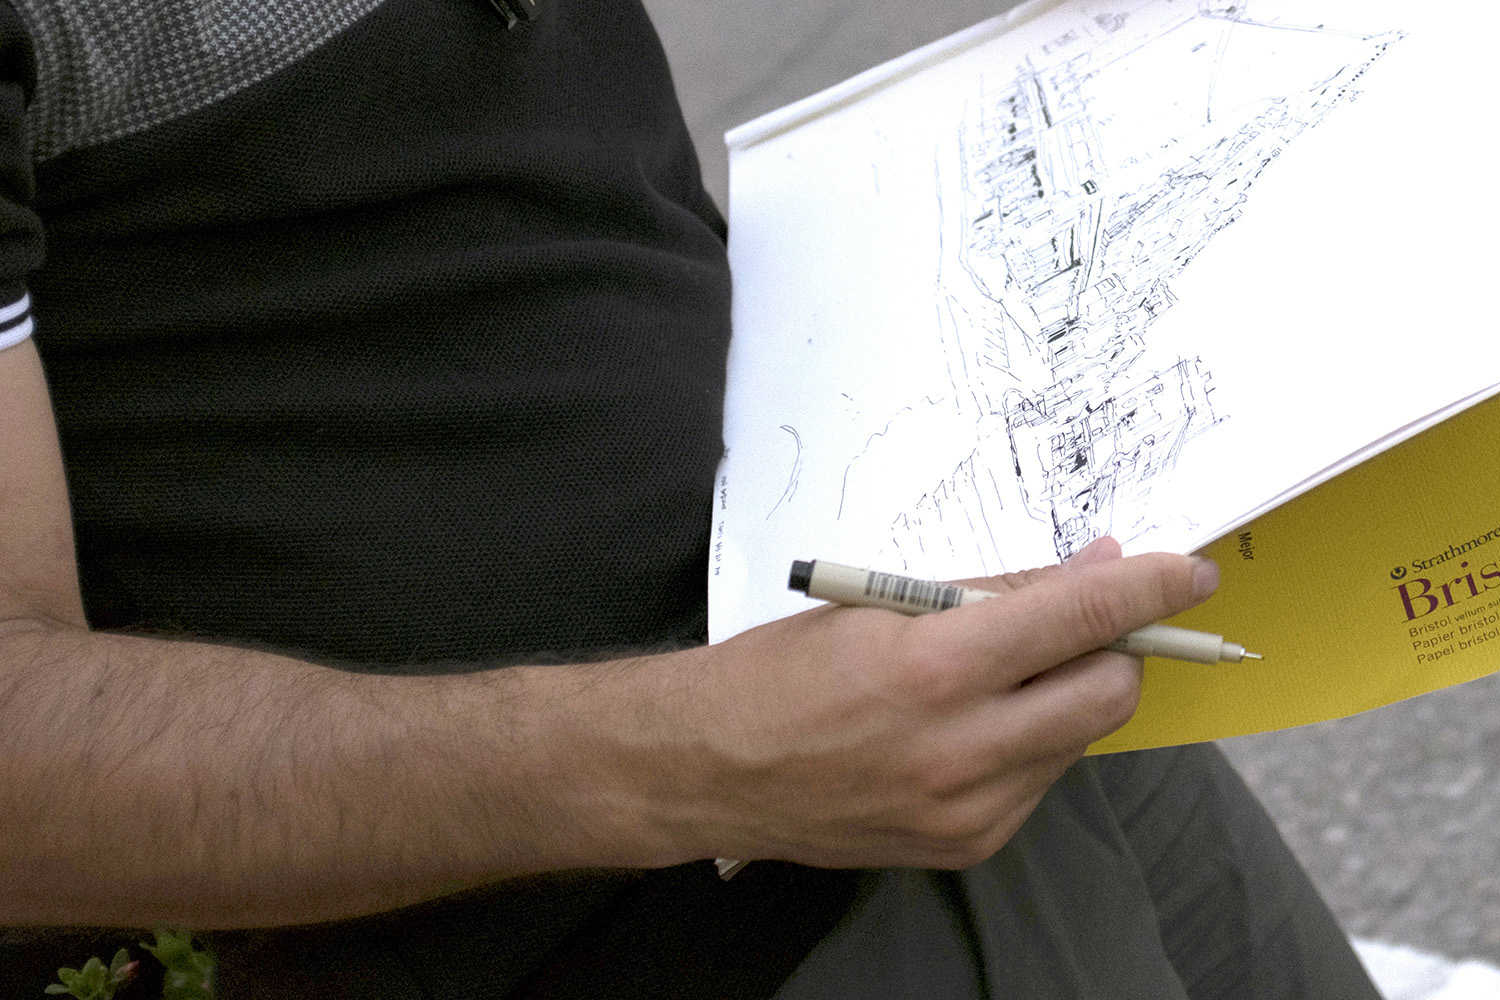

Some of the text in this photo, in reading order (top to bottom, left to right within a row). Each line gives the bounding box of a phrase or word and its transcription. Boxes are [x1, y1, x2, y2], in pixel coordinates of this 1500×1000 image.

[1238, 531, 1257, 561] Mejor
[1408, 616, 1451, 639] Bristol
[1454, 605, 1487, 623] vellum
[1413, 630, 1456, 652] Papier
[1459, 613, 1500, 636] bristol
[1417, 646, 1456, 665] Papel
[1460, 629, 1500, 651] bristol
